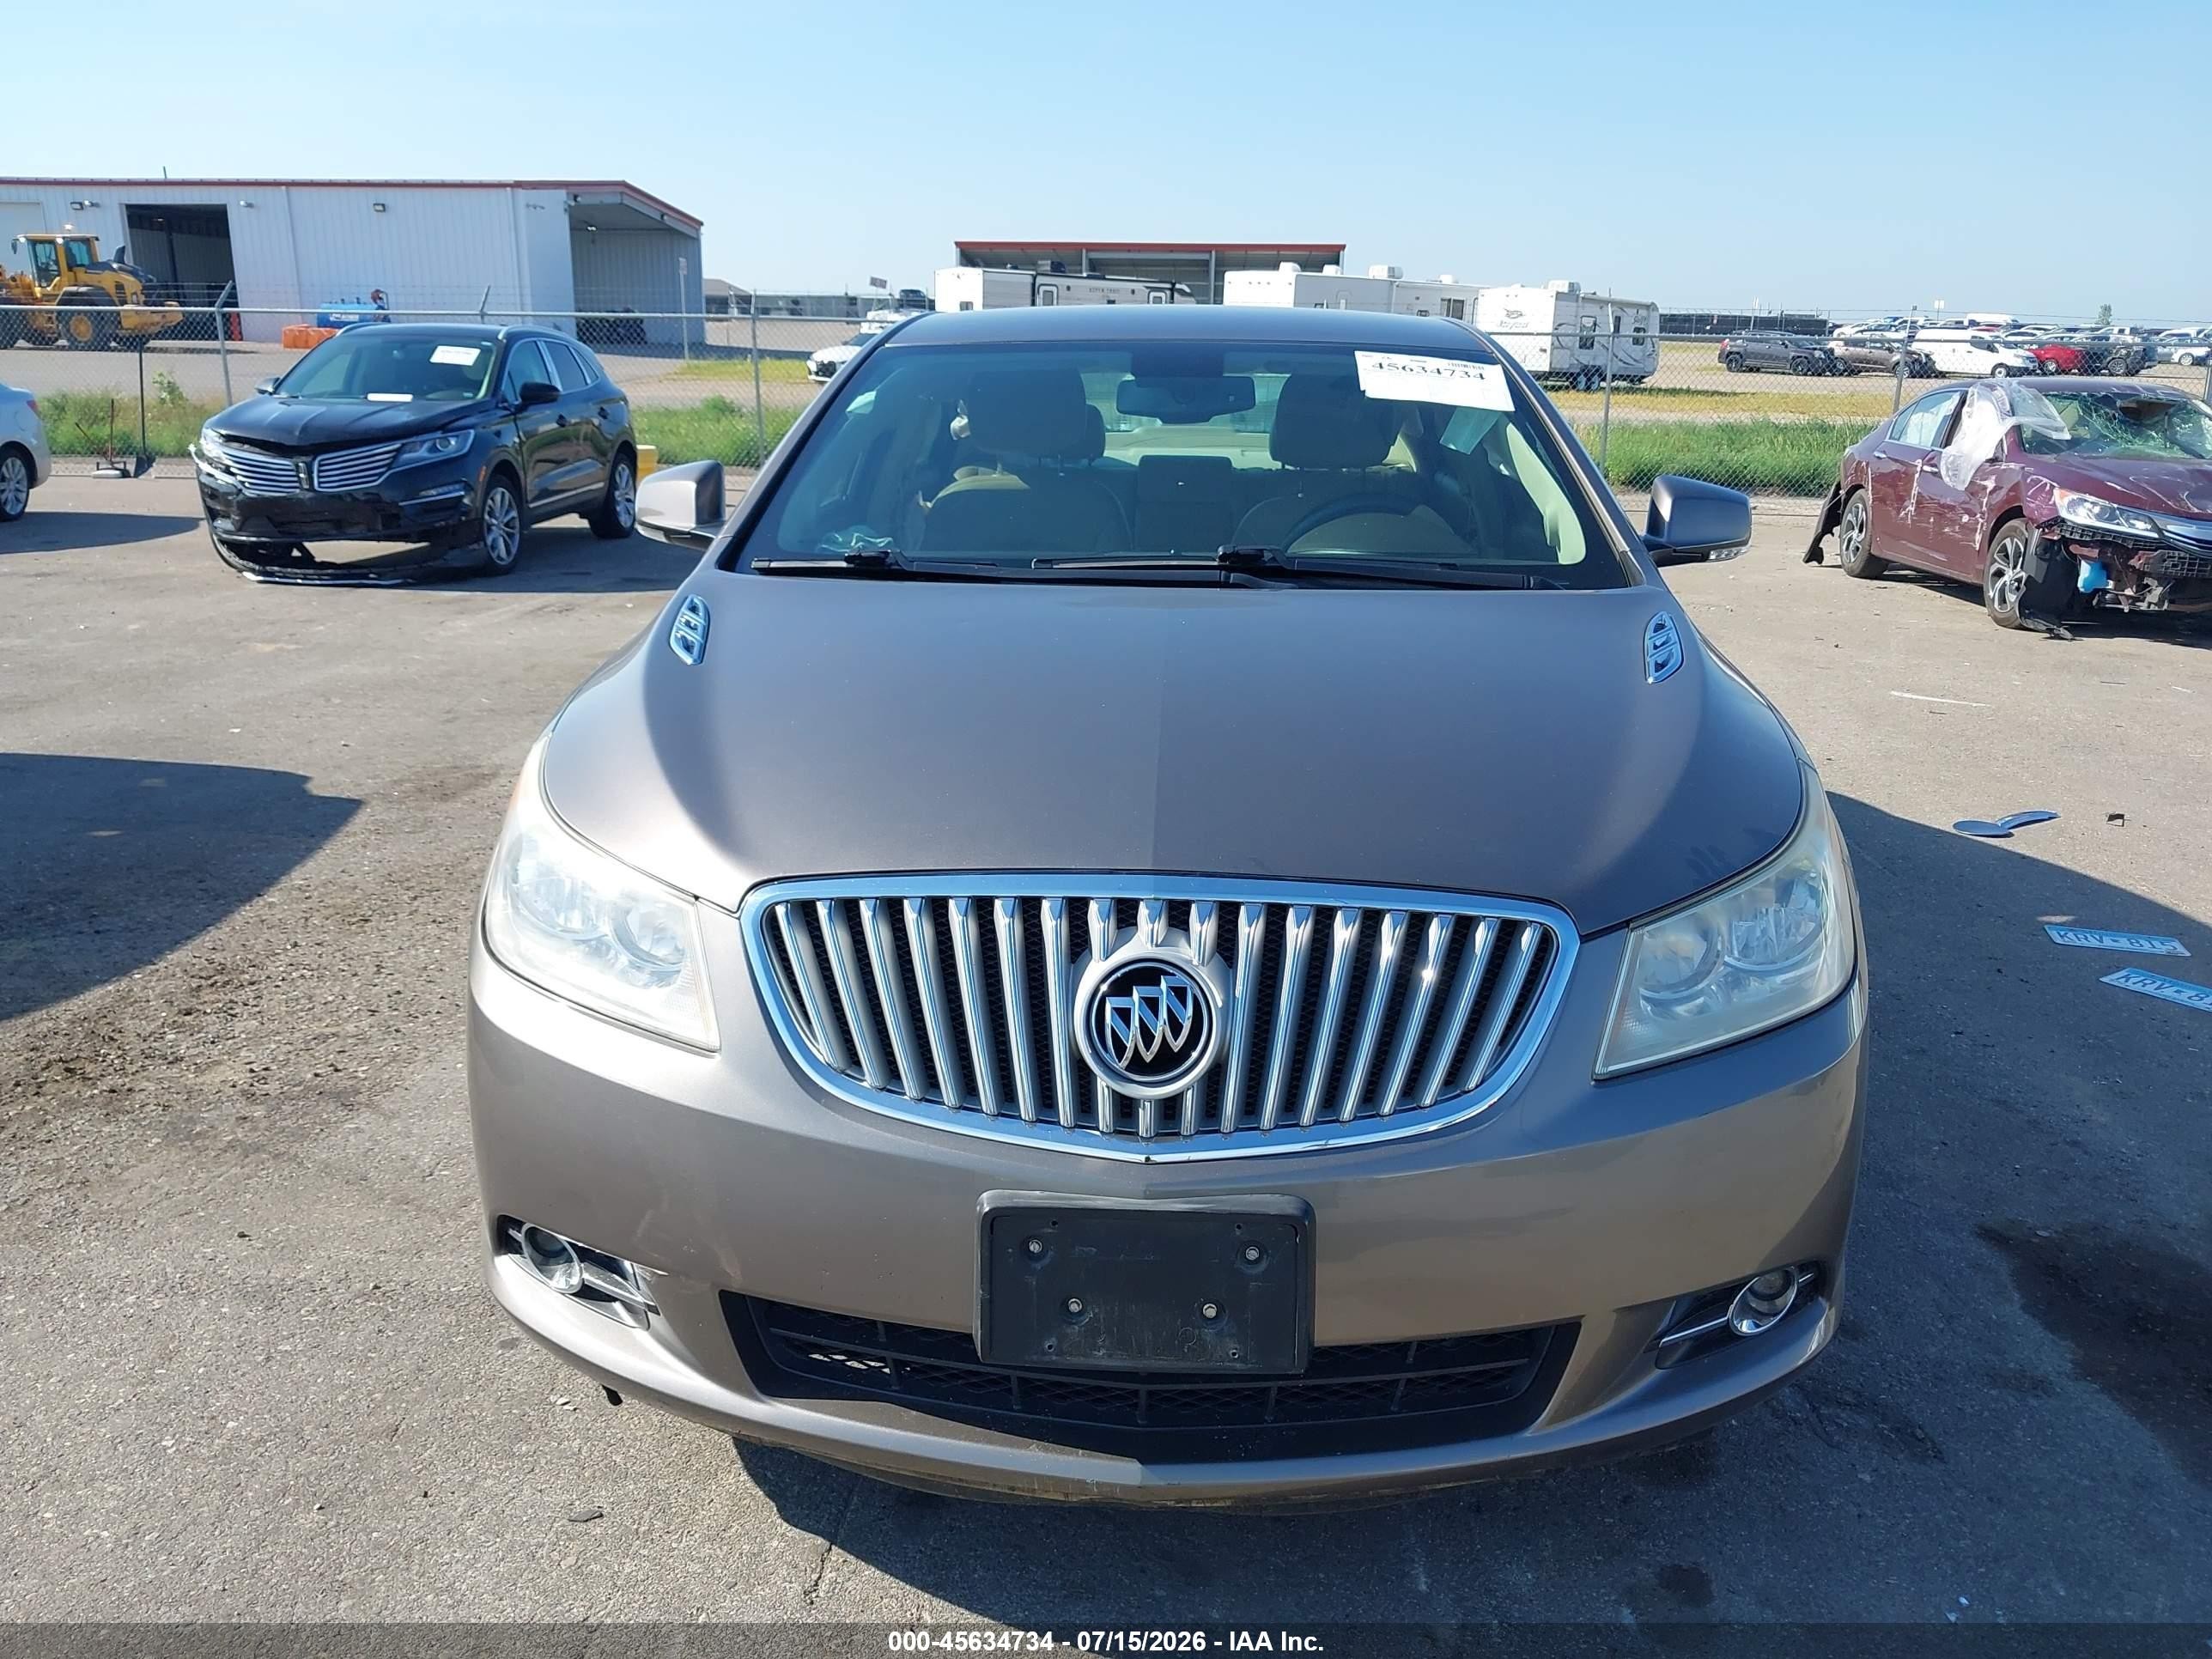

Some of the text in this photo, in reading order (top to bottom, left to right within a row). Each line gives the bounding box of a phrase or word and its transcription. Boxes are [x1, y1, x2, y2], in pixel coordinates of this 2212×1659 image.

[1371, 362, 1486, 380] 45634734
[2056, 931, 2179, 951] KRV 815
[2116, 973, 2174, 991] KRV
